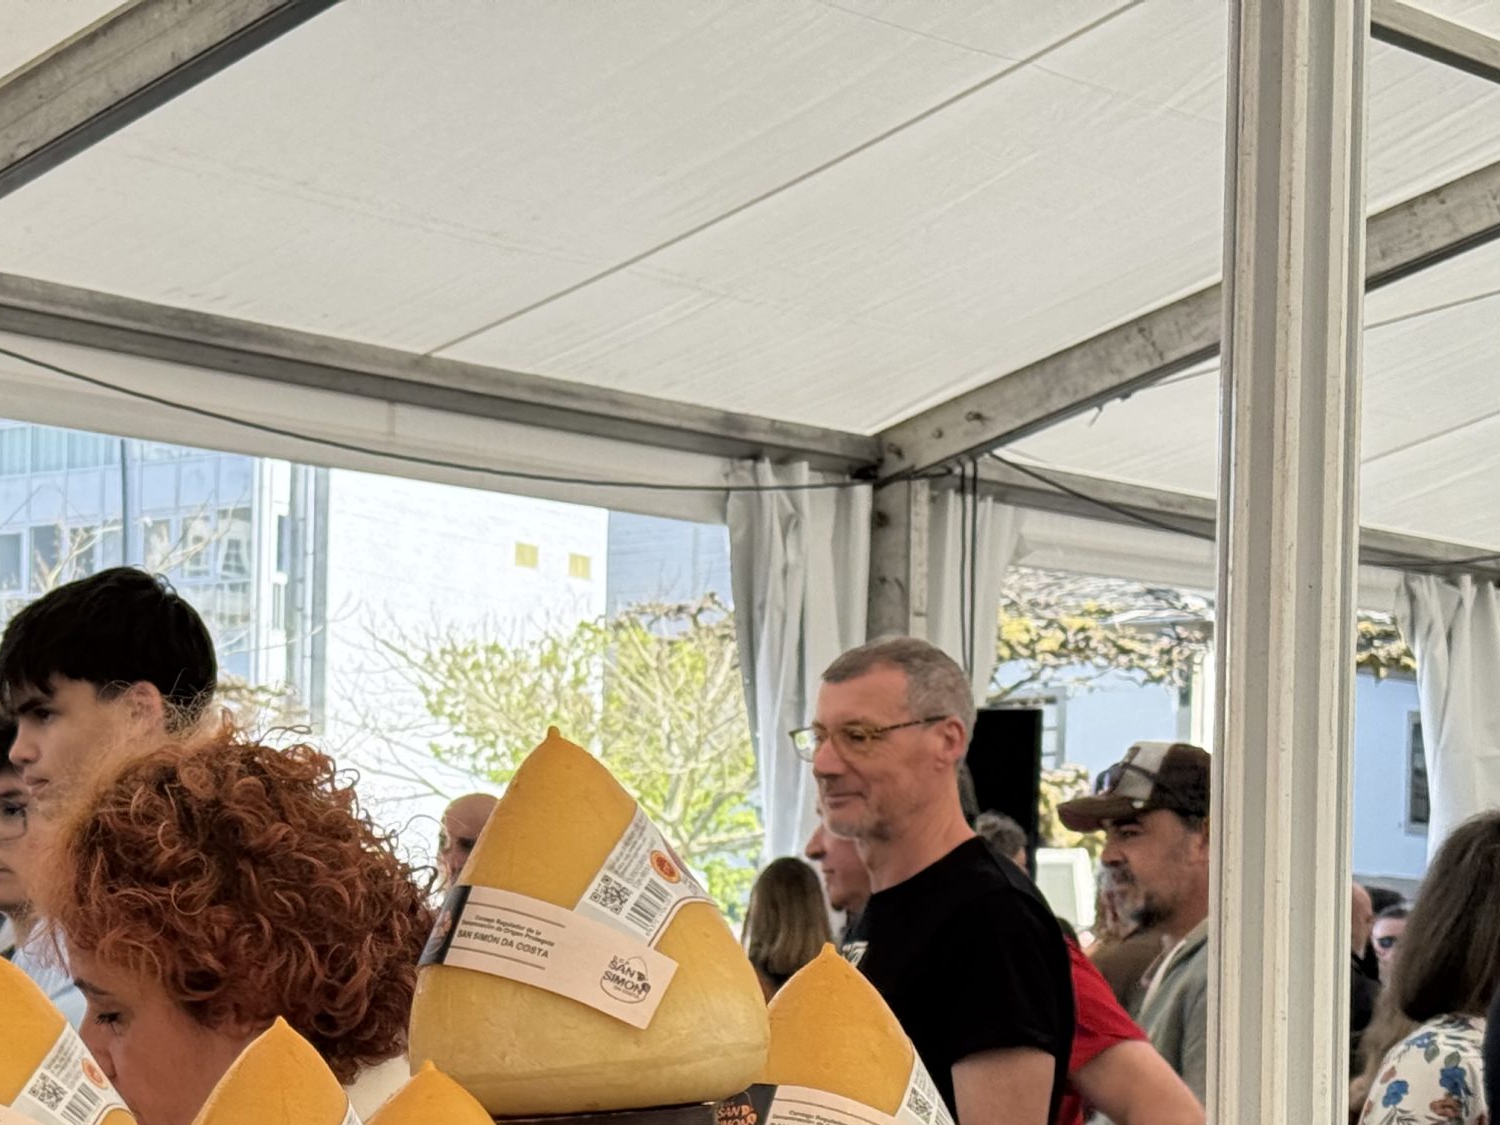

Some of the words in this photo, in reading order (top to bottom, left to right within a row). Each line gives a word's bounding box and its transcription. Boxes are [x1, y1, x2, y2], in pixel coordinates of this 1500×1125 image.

[457, 930, 473, 940] SAN
[501, 938, 514, 949] DA
[515, 941, 550, 959] COSTA
